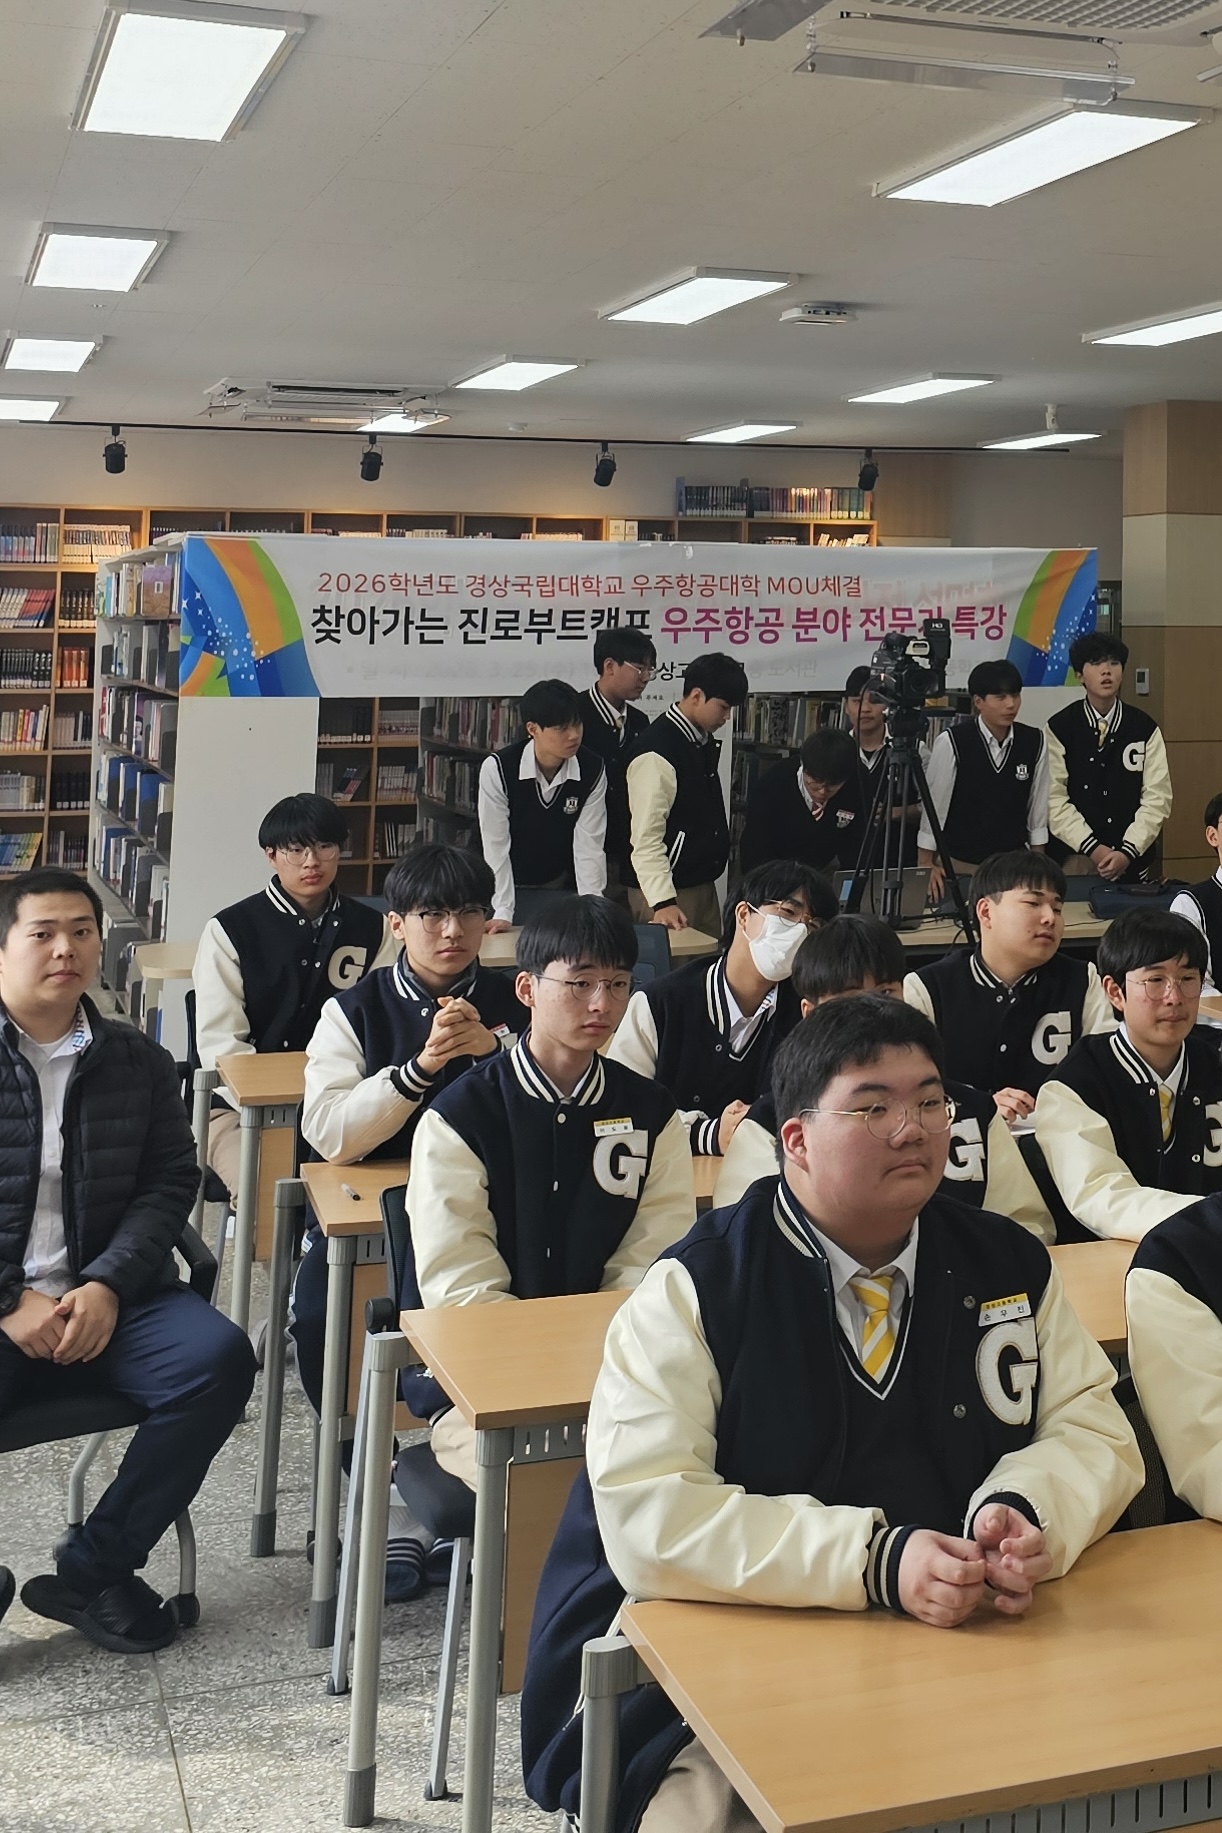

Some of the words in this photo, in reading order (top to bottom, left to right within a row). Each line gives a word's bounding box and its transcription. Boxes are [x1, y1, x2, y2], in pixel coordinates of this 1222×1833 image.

[318, 572, 459, 597] 2026학년도
[465, 574, 626, 599] 경상국립대학교
[630, 574, 761, 598] 우주항공대학
[768, 575, 863, 600] MOU체결
[310, 604, 449, 646] 찾아가는
[661, 606, 785, 645] 우주항공
[792, 606, 852, 643] 분야
[951, 604, 1008, 641] 특강
[1122, 741, 1146, 772] G
[329, 946, 368, 990] G
[1031, 1011, 1073, 1066] G
[592, 1129, 649, 1200] G
[975, 1316, 1040, 1427] G
